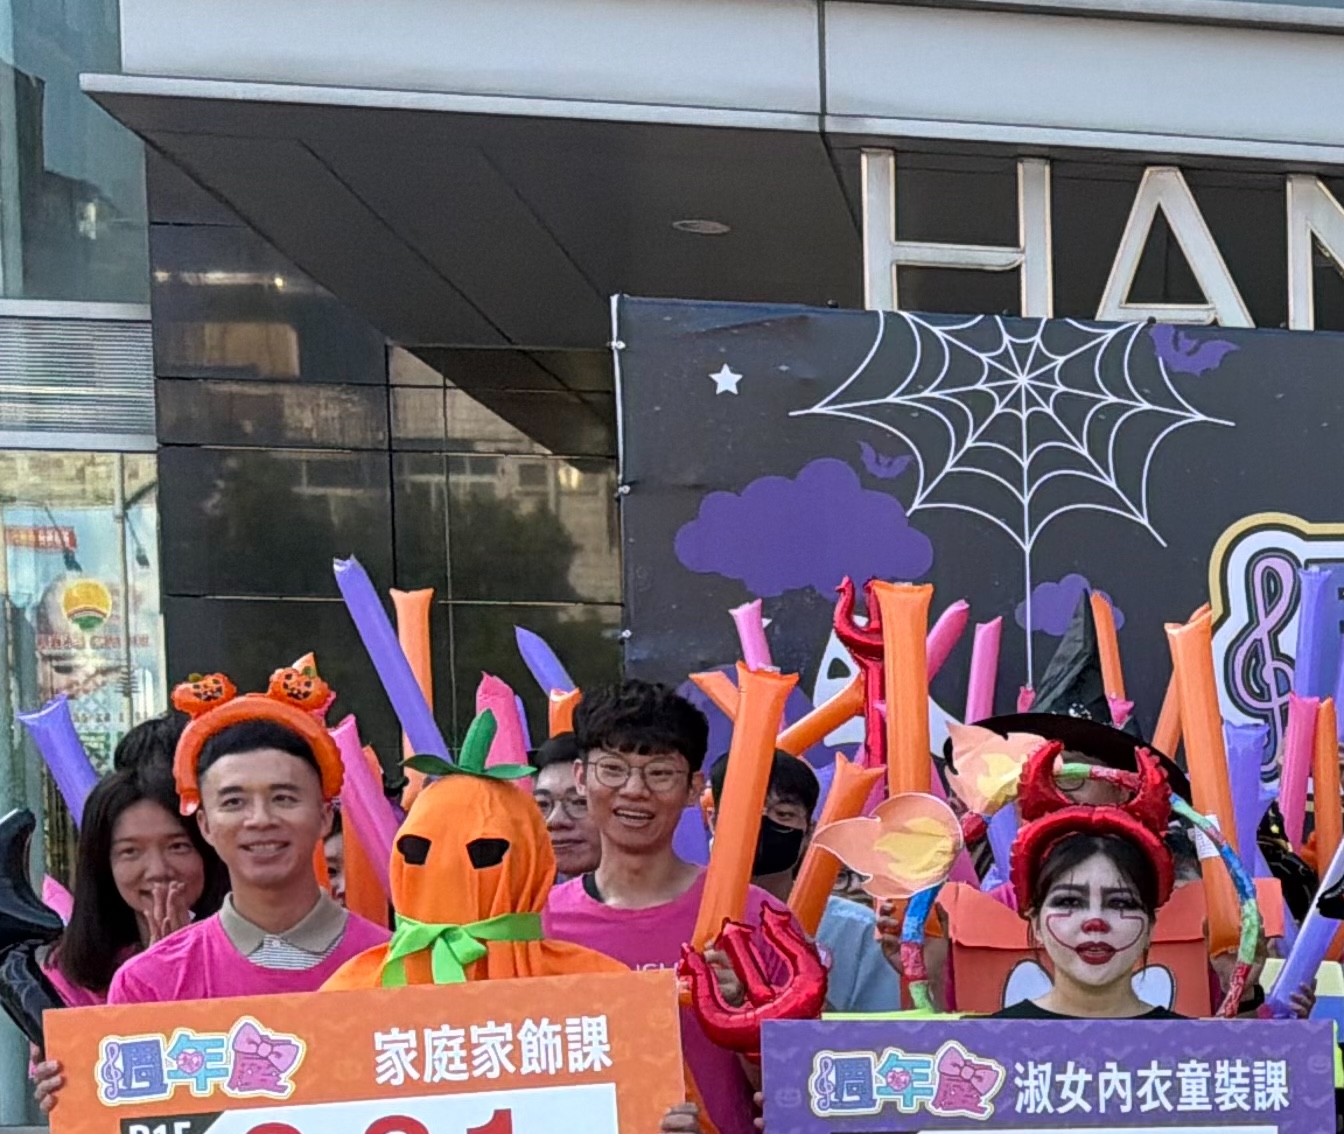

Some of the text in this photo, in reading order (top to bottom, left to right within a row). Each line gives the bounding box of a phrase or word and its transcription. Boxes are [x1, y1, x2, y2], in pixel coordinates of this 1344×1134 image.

[374, 1013, 613, 1086] 家庭家飾課
[1014, 1059, 1290, 1115] 淑女內衣童裝課
